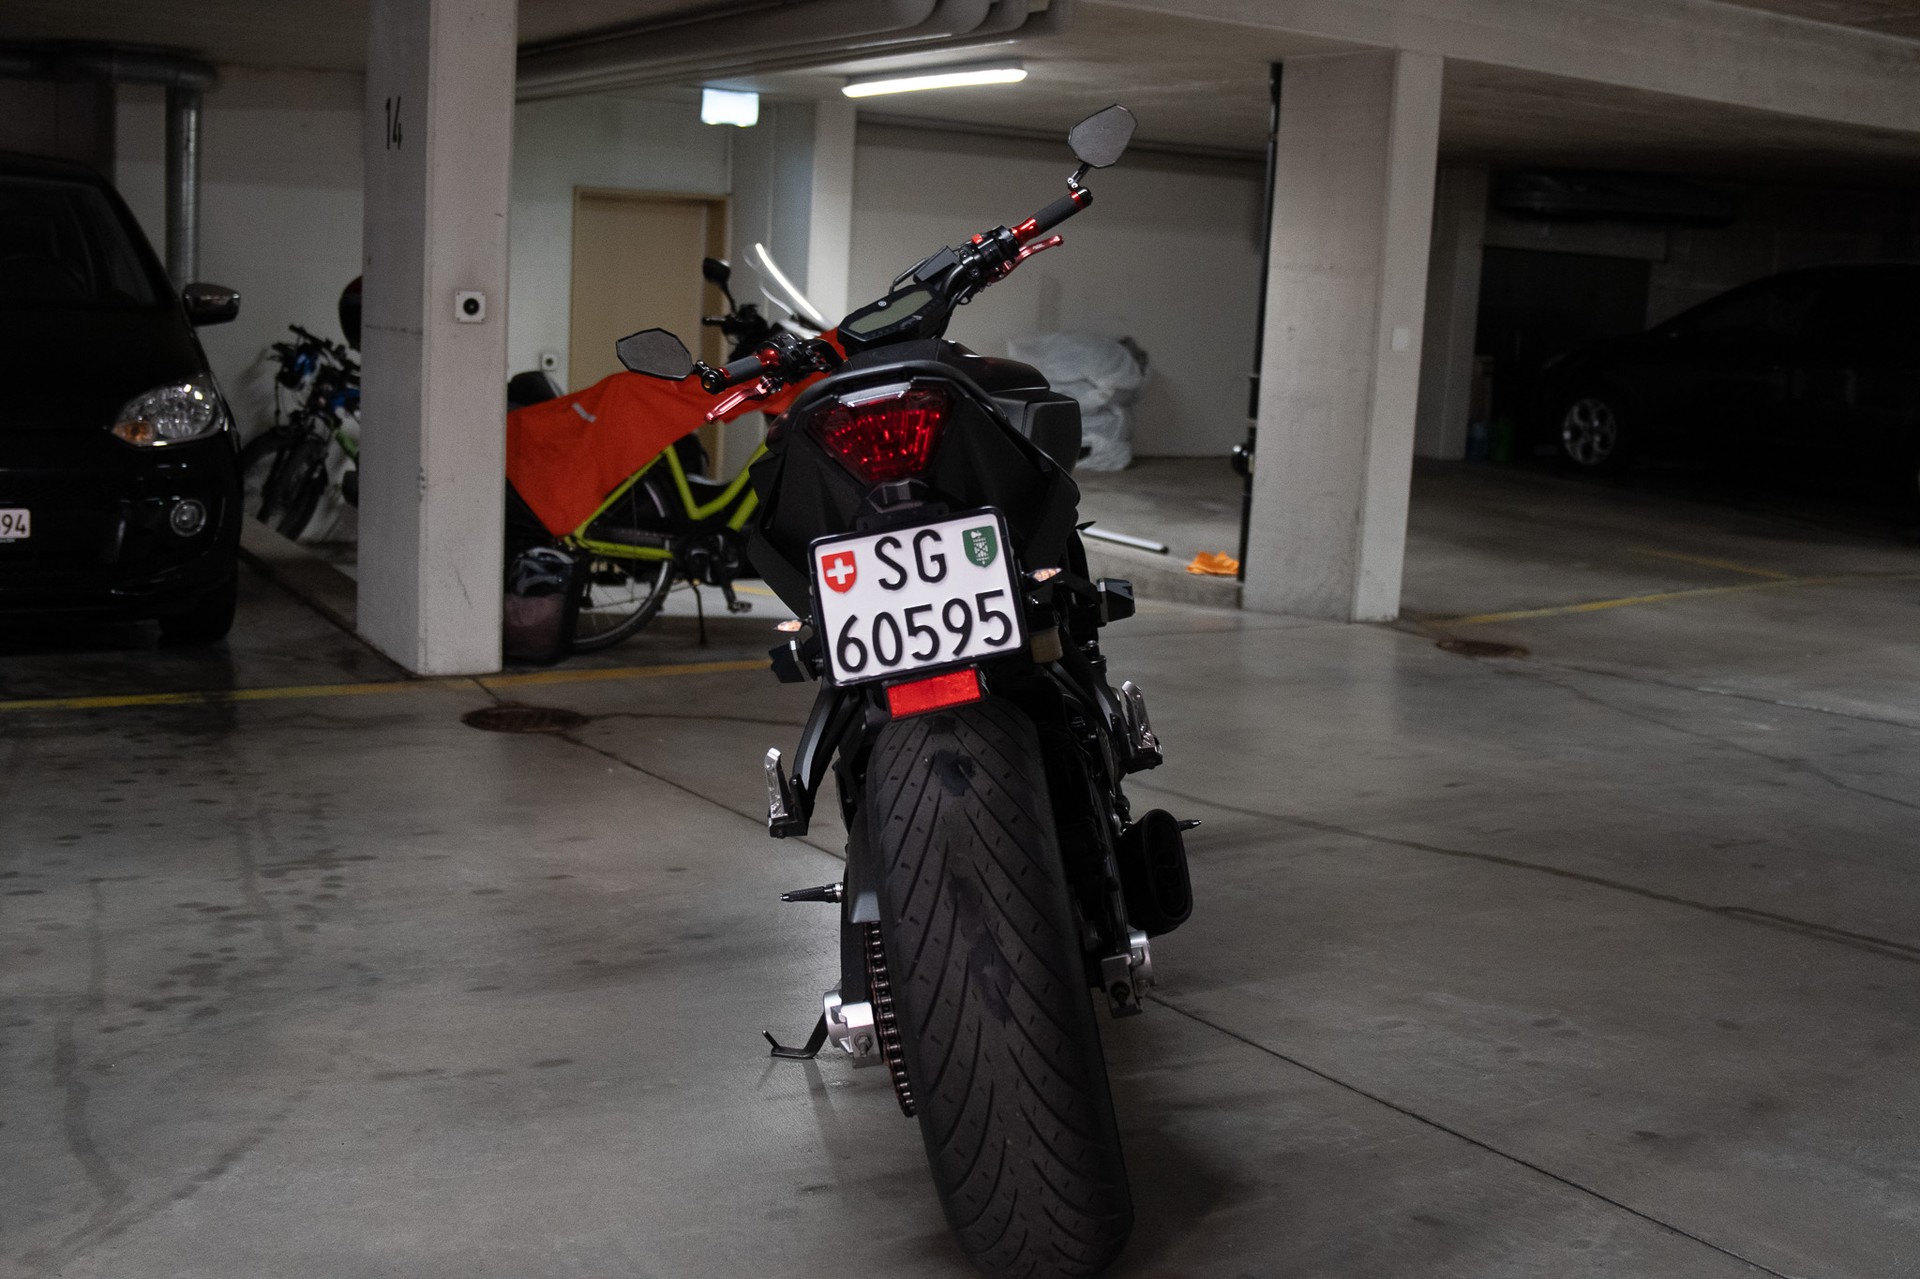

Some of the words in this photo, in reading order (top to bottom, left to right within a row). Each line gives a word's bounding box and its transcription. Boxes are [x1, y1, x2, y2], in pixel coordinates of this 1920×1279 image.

[386, 96, 402, 150] 14
[2, 514, 26, 535] 94
[874, 529, 947, 591] SG
[836, 589, 1013, 673] 60595
